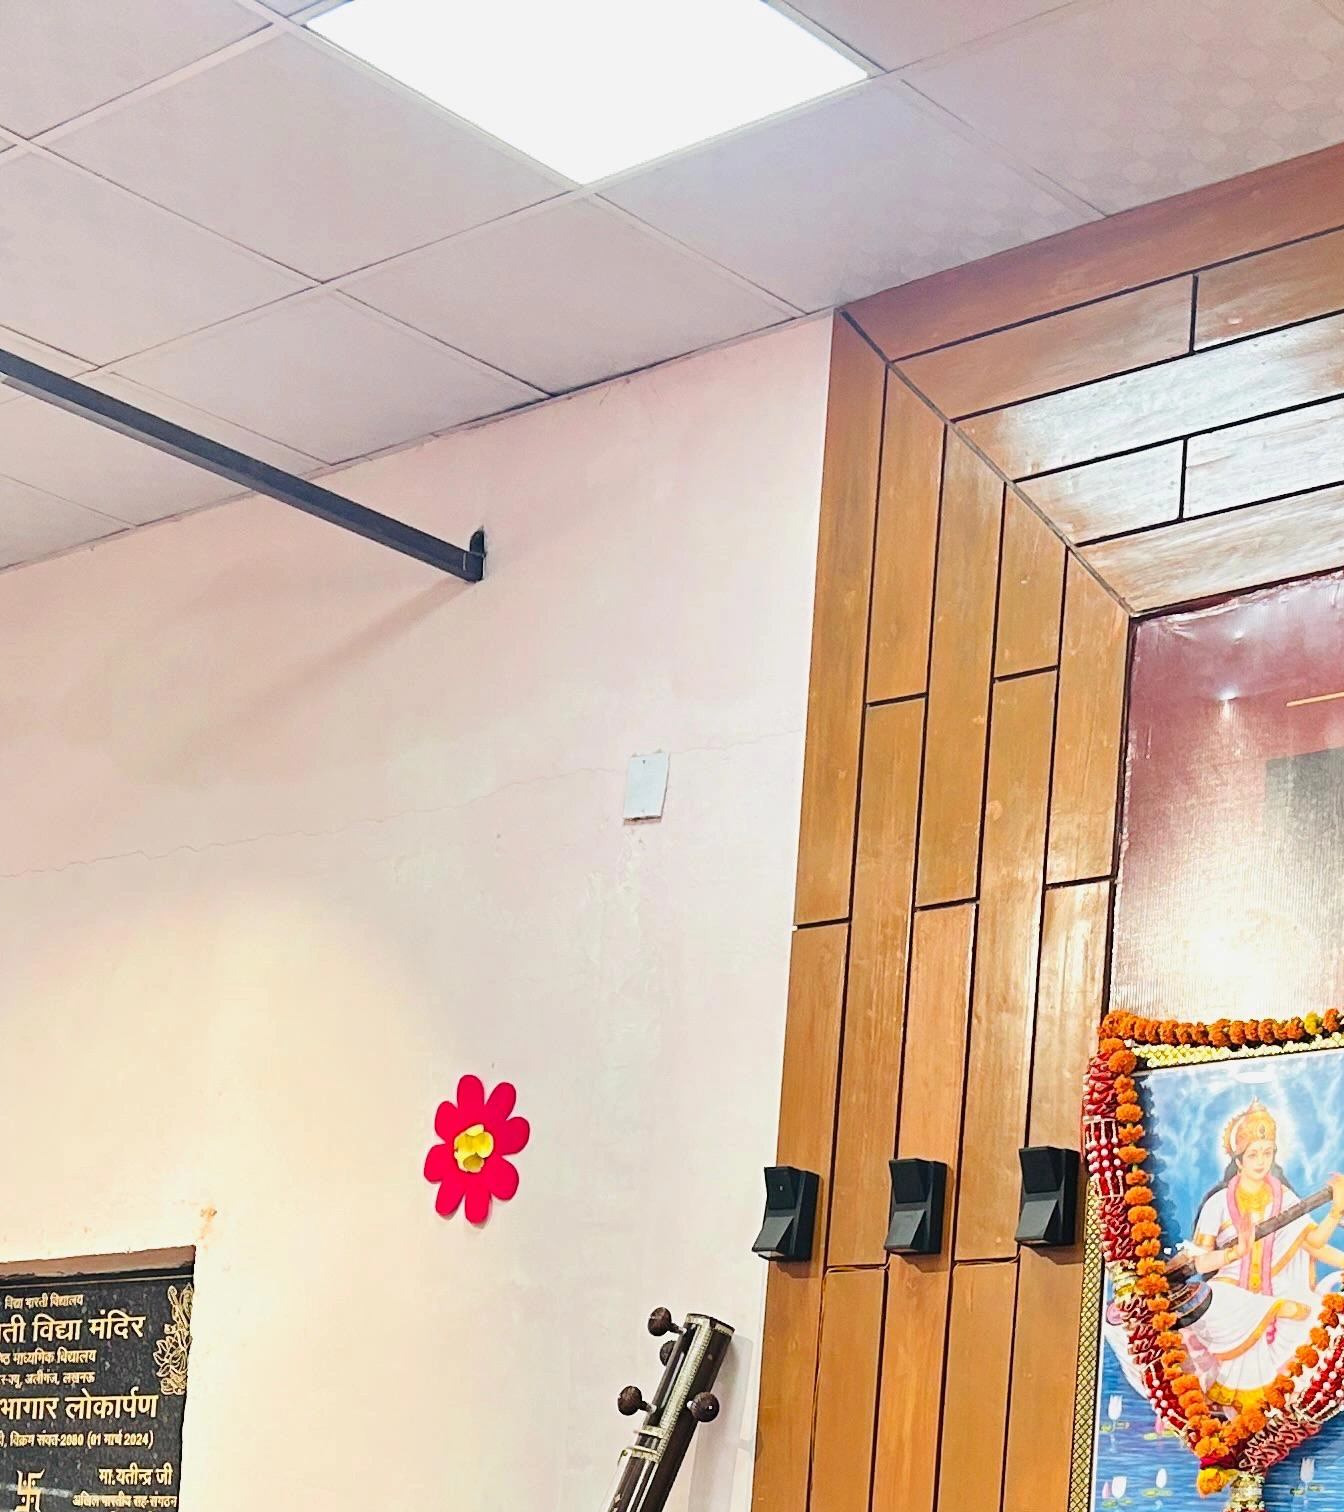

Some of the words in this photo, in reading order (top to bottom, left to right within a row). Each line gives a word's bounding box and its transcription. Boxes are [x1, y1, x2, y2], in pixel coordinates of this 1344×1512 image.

[50, 1292, 84, 1308] विद्यालय
[32, 1313, 83, 1342] विद्या
[89, 1309, 146, 1340] मंदिर
[56, 1347, 97, 1364] विद्यालय
[65, 1386, 159, 1420] लोकार्पण
[156, 1462, 173, 1486] जी
